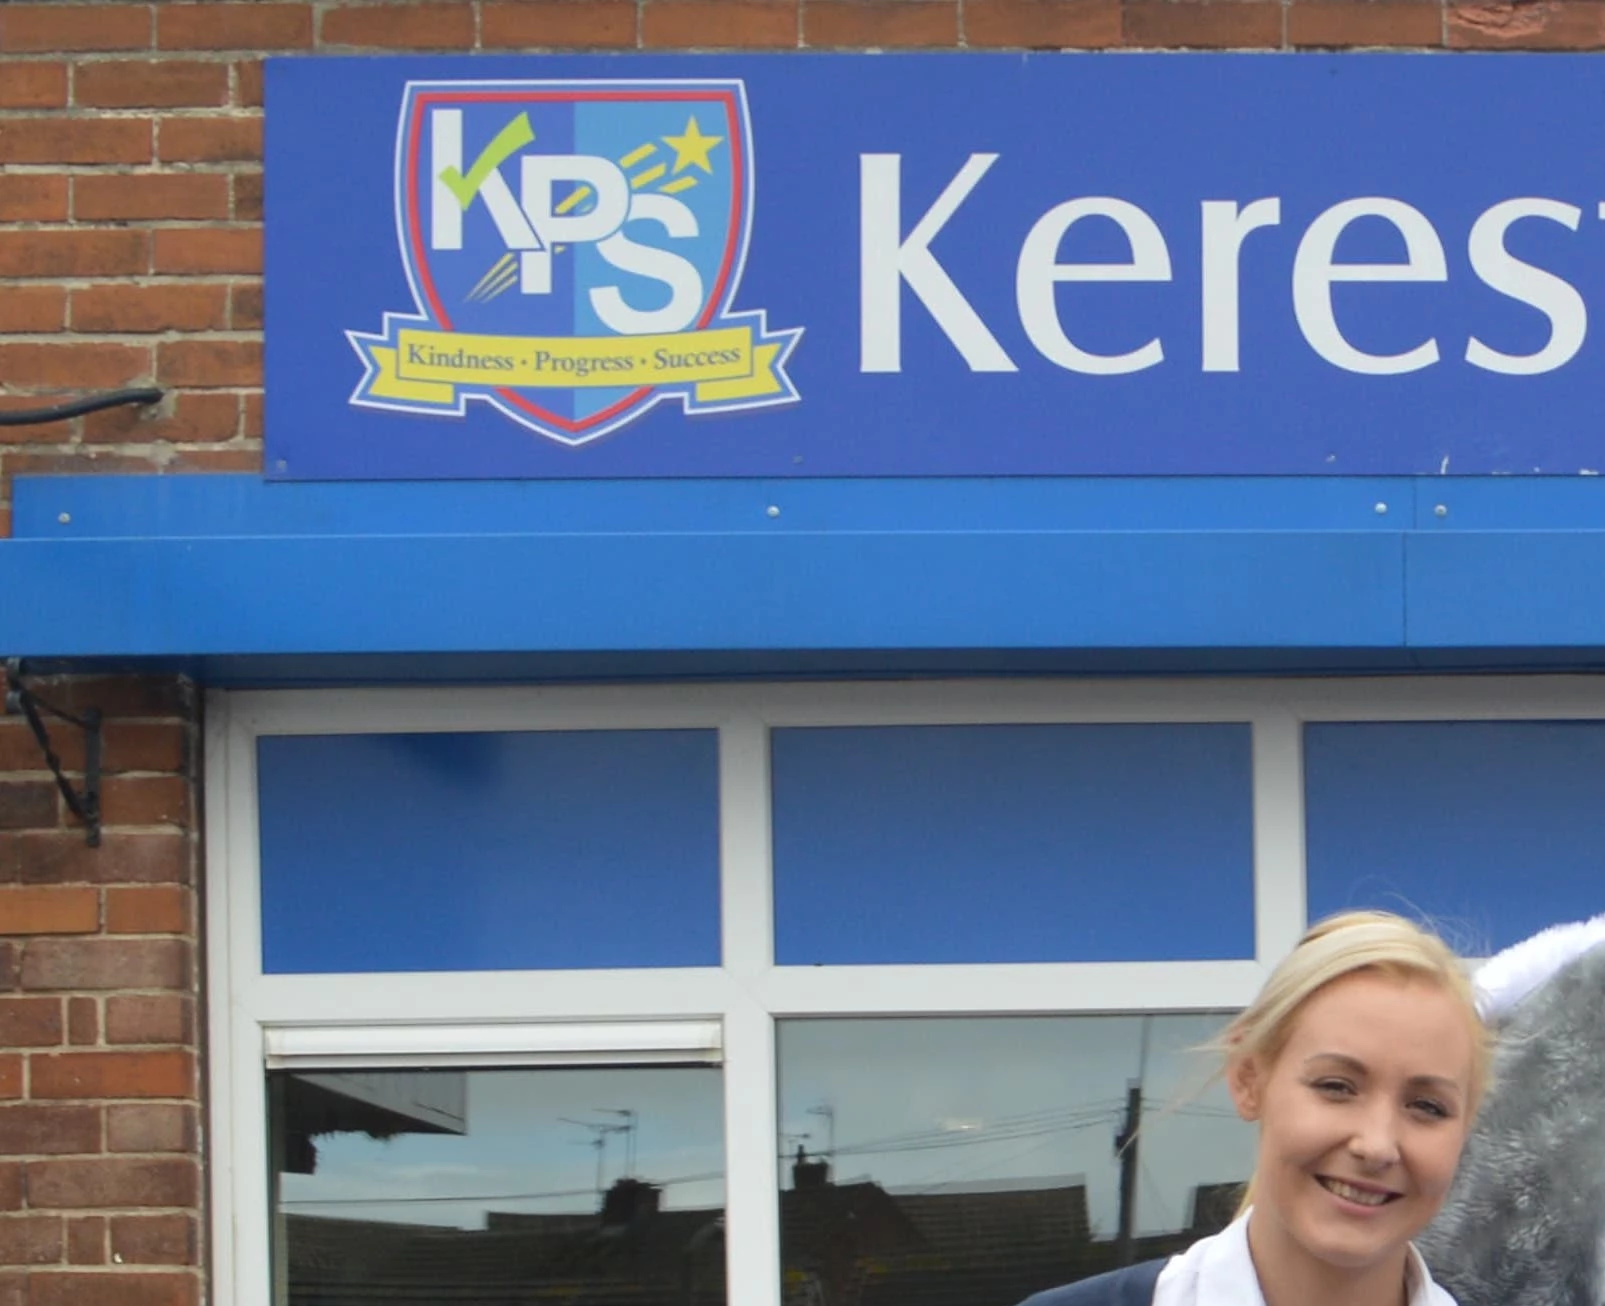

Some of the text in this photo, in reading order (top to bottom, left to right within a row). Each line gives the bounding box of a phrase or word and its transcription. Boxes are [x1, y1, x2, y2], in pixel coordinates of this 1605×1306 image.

[431, 108, 704, 337] KPS
[407, 343, 741, 377] Kindness Progress Success
